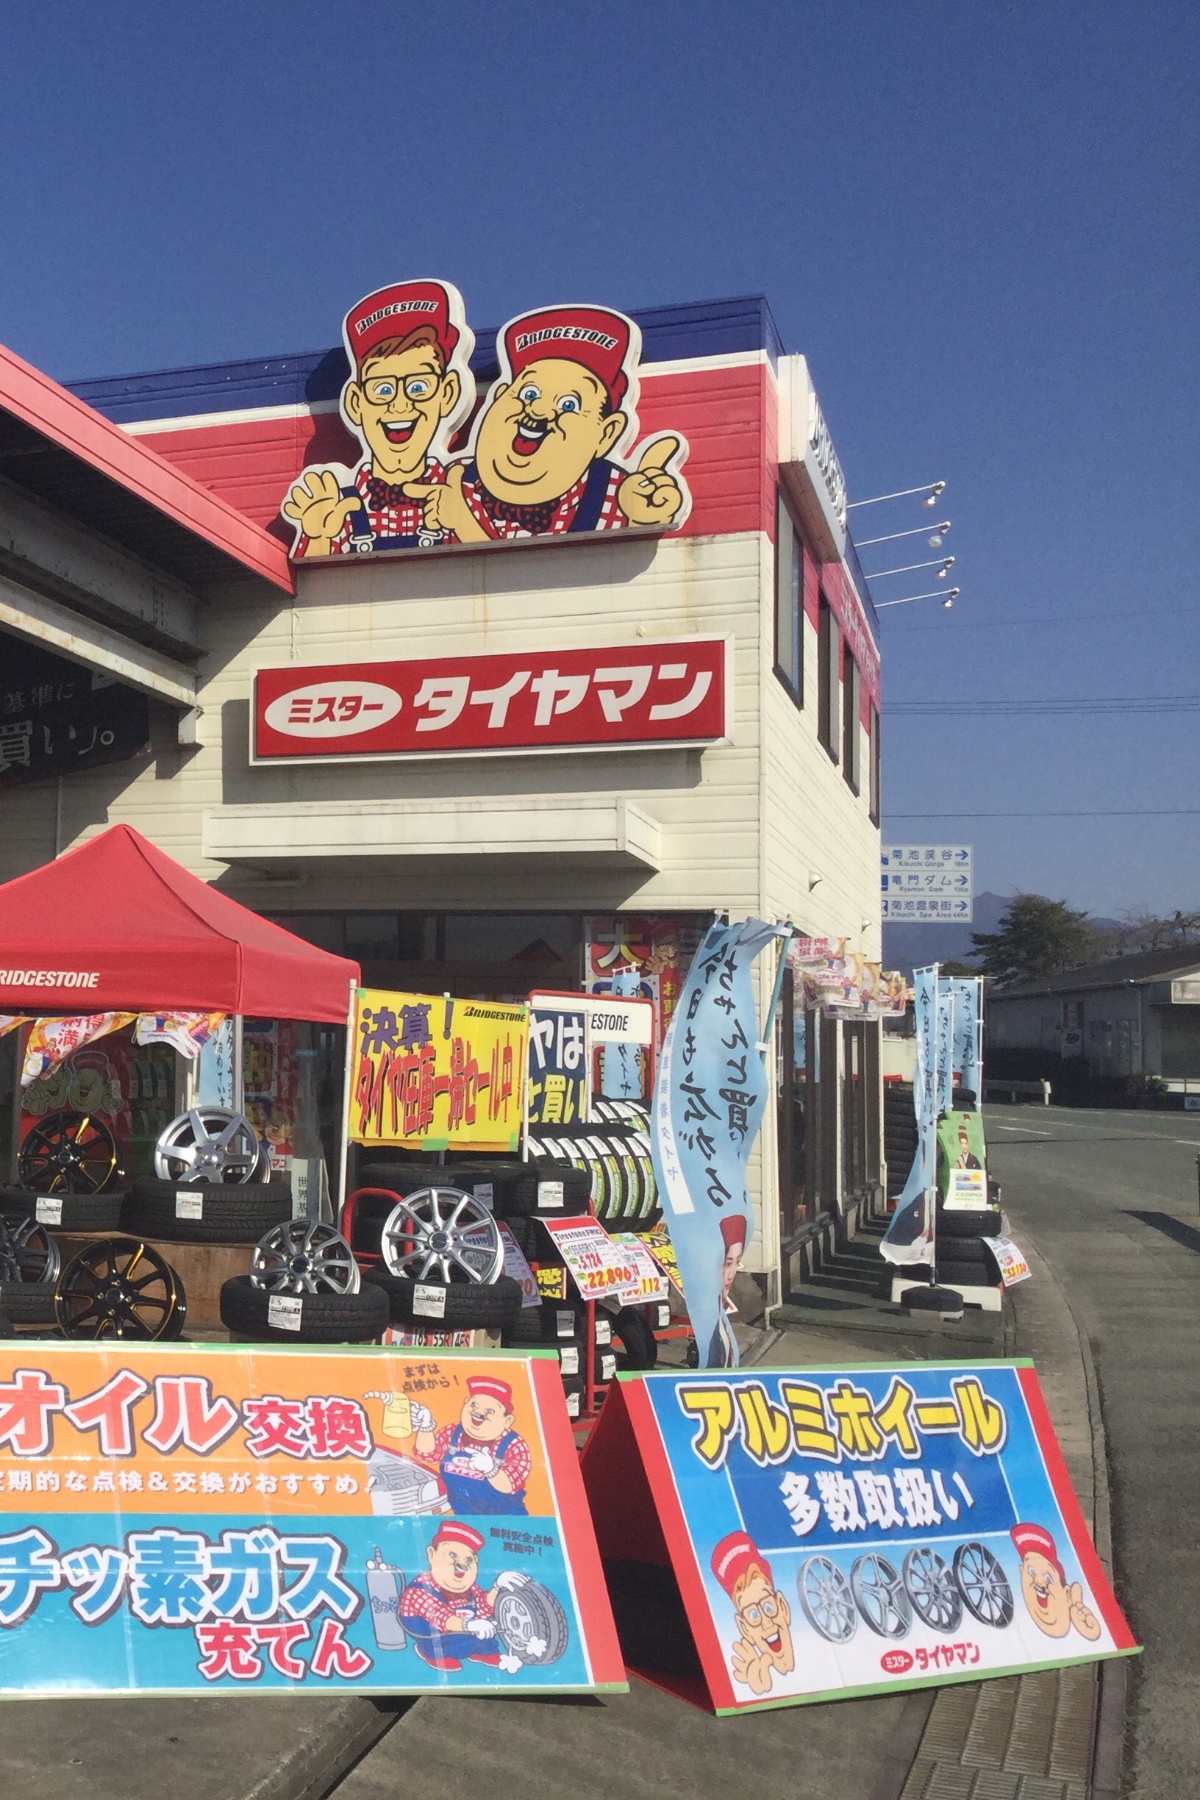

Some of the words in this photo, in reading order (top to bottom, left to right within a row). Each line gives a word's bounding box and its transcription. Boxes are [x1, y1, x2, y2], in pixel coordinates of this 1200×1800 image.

[355, 300, 439, 336] BRIDGESTONE
[515, 326, 619, 353] BRIDGESTONE
[287, 694, 384, 724] ミスター
[413, 663, 713, 732] タイヤマン
[463, 1006, 527, 1023] BRIDGESTONE
[591, 1013, 629, 1032] ESTONE
[402, 1363, 441, 1378] まずは
[675, 1375, 1008, 1471] アルミホイール
[778, 1466, 975, 1537] 多数取扱い
[196, 1618, 375, 1680] 充てん
[884, 1655, 911, 1670] ミスター
[914, 1642, 981, 1670] タイヤマン
